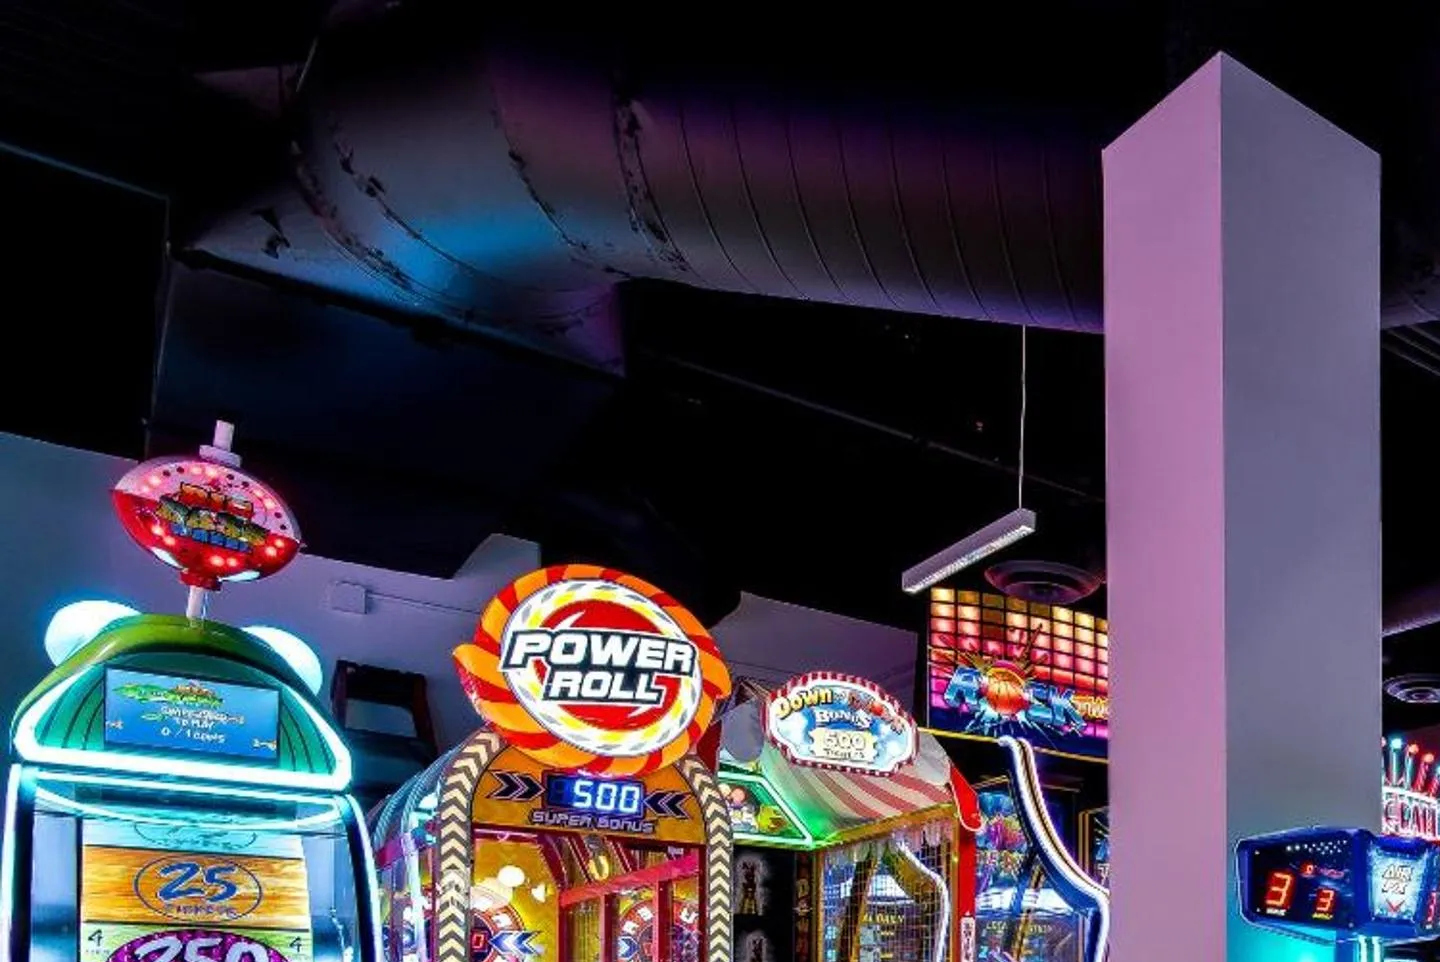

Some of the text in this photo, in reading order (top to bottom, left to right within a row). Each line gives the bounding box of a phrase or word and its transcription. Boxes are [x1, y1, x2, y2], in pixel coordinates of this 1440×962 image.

[509, 632, 695, 673] POWER
[548, 670, 659, 701] ROLL
[573, 779, 640, 813] 500
[532, 810, 592, 828] SUPER
[155, 861, 239, 903] 25
[1265, 871, 1292, 906] 3
[1316, 889, 1335, 912] 3
